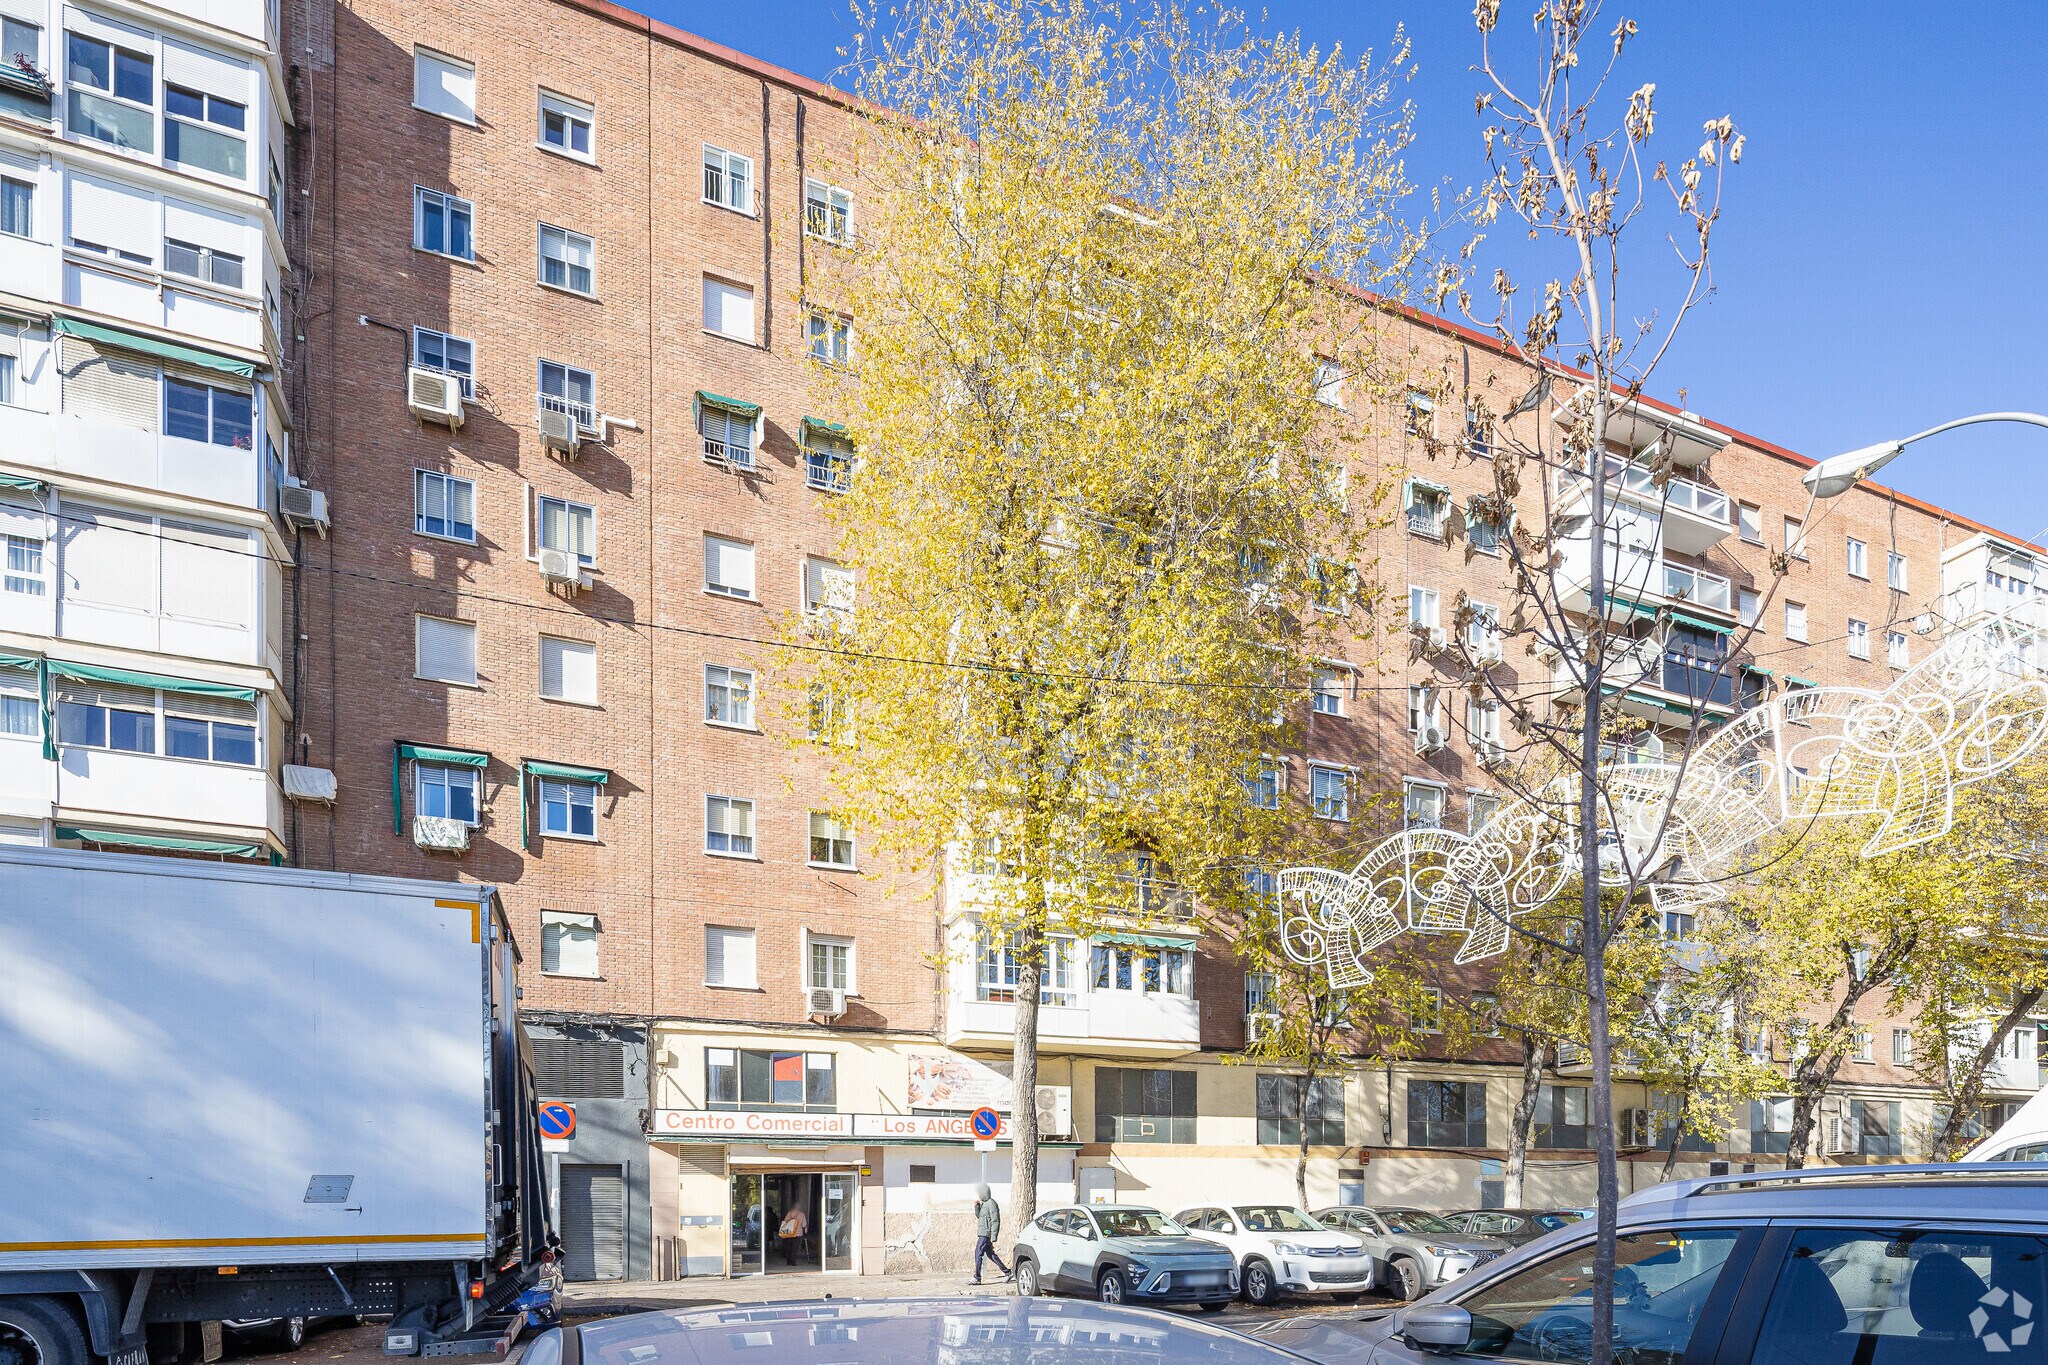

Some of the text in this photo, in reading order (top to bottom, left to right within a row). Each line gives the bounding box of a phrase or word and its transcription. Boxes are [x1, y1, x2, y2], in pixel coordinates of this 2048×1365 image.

[665, 1112, 735, 1130] Centro
[746, 1114, 844, 1132] Comercial
[925, 1119, 1008, 1135] ANGES
